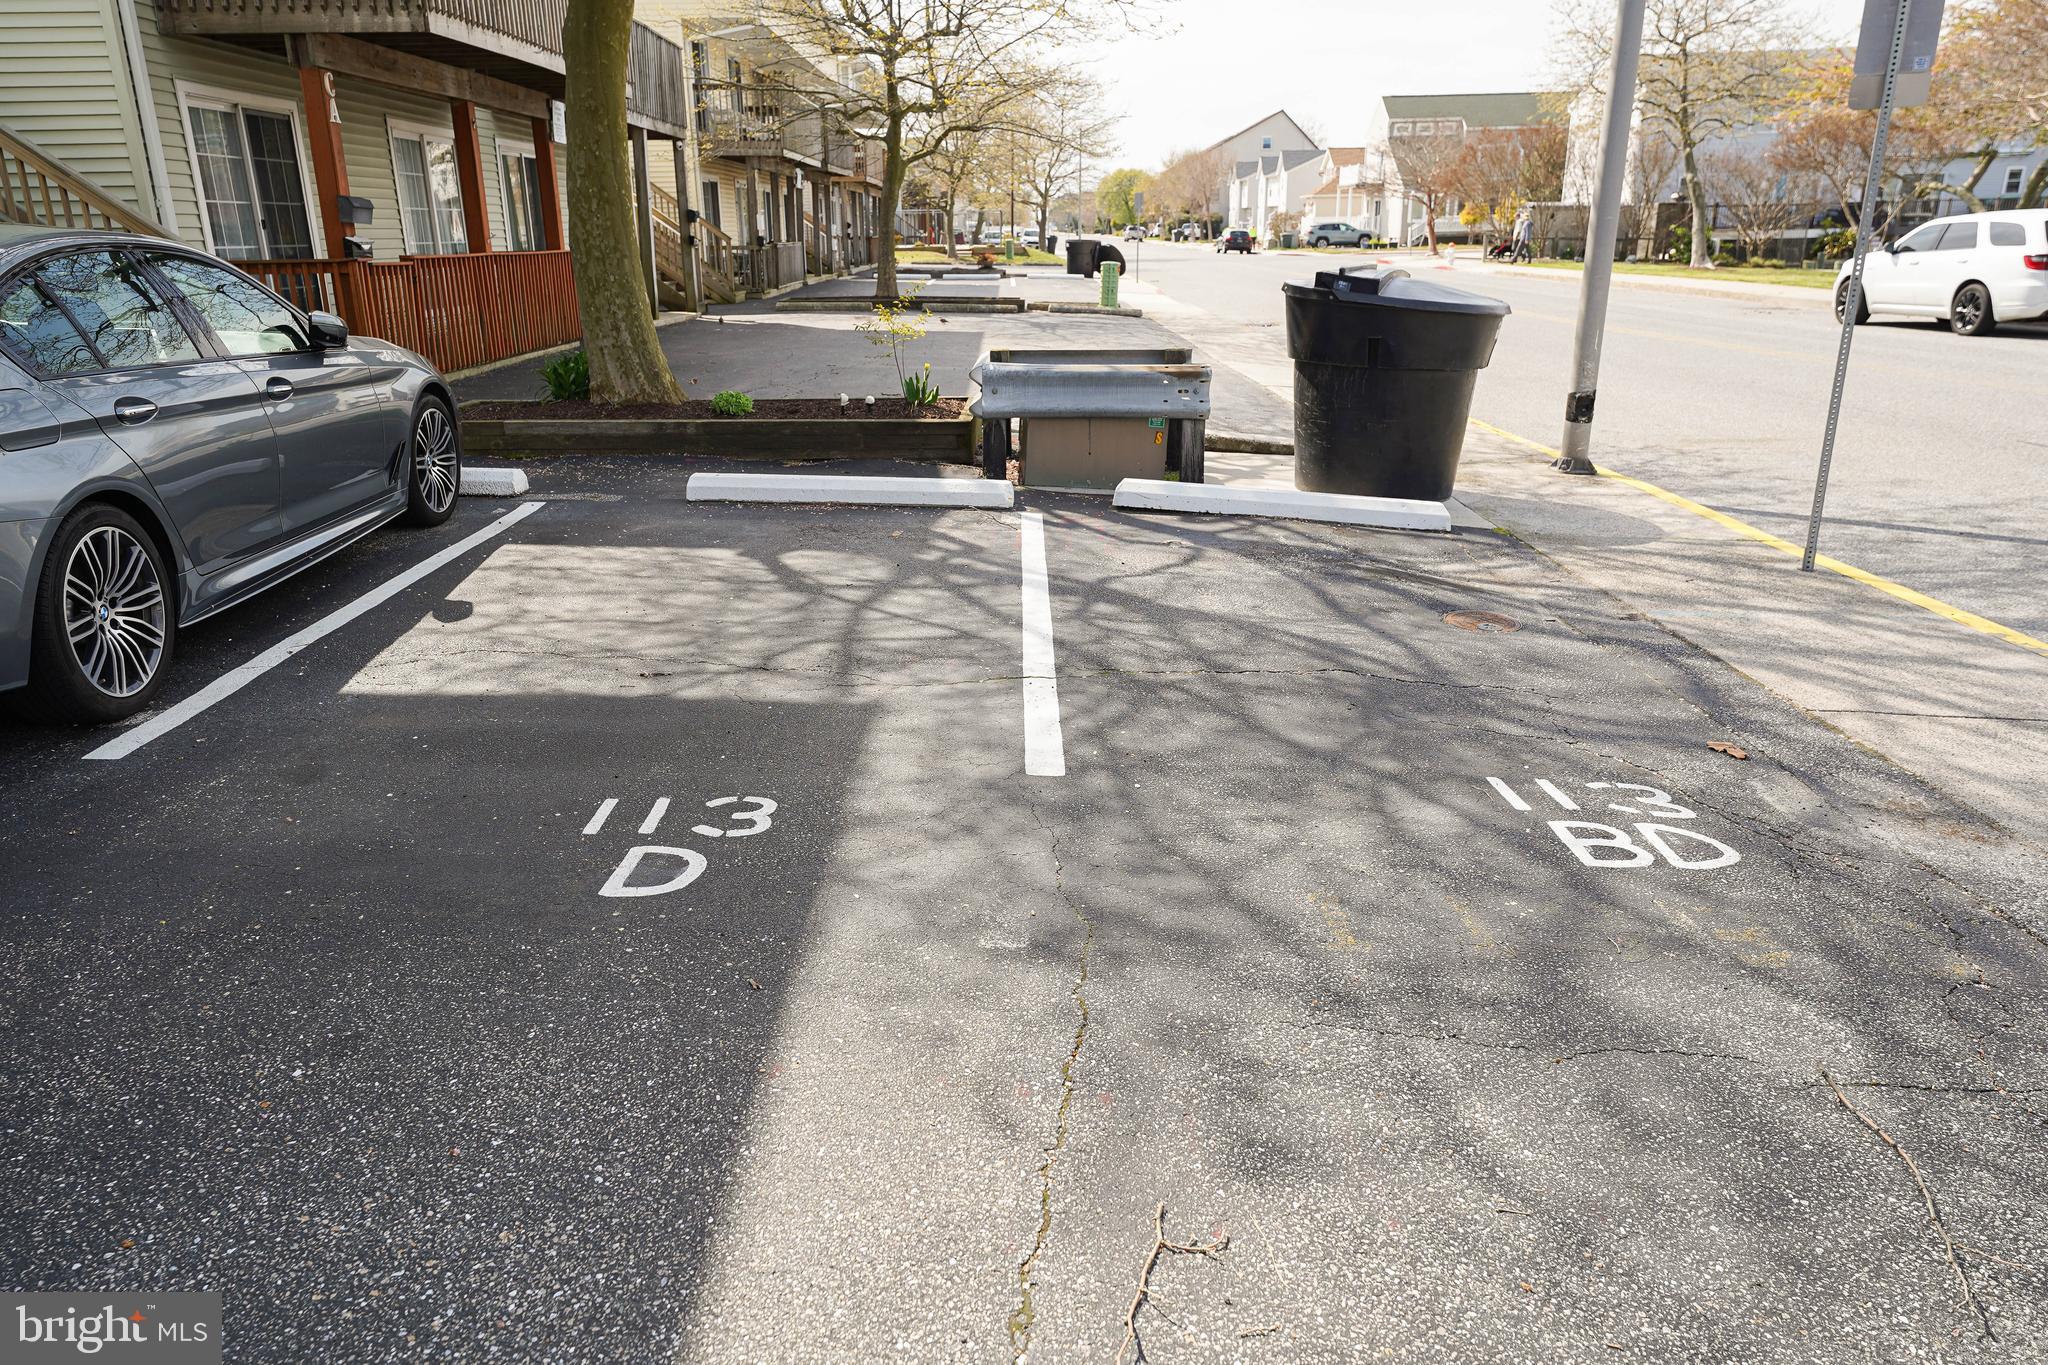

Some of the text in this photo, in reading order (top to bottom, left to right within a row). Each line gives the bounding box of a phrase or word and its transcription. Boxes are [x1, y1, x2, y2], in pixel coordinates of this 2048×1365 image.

[1155, 431, 1163, 445] S
[582, 796, 778, 837] 113
[1486, 783, 1697, 818] 113
[1547, 821, 1741, 870] BD
[598, 845, 708, 897] D
